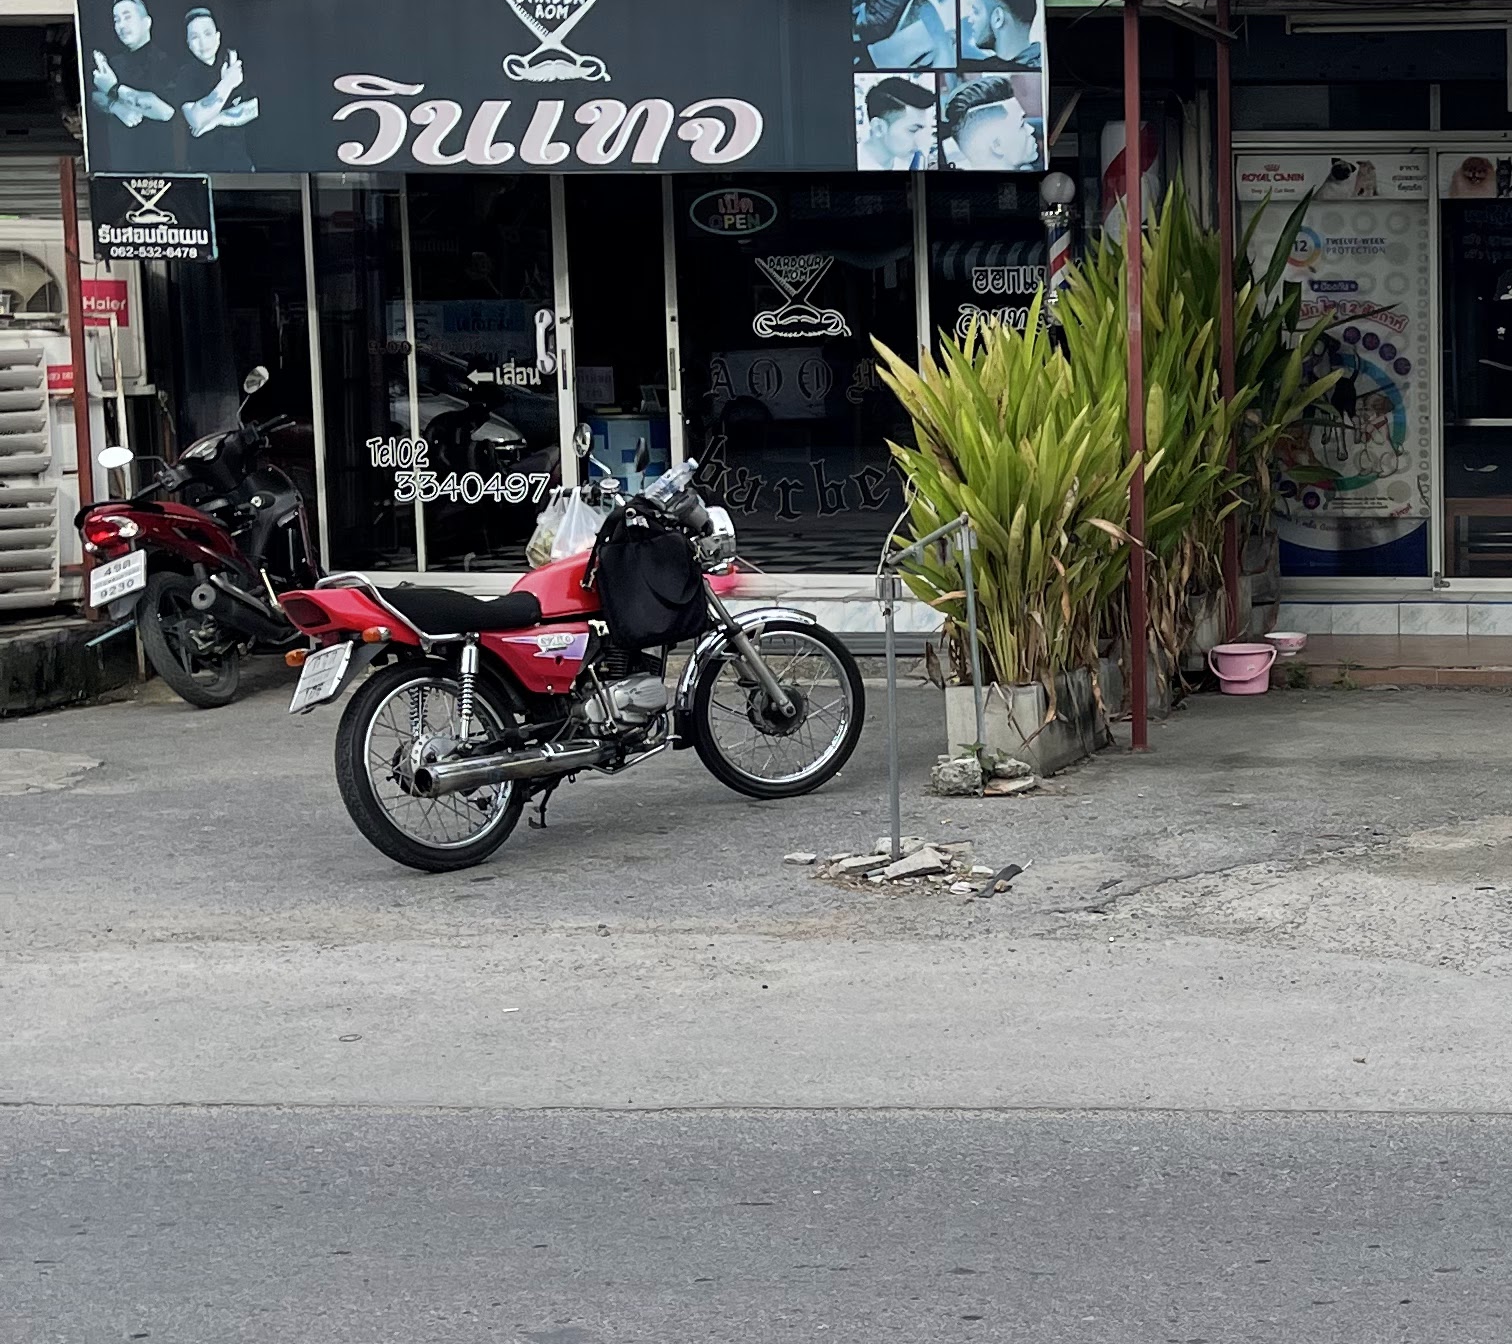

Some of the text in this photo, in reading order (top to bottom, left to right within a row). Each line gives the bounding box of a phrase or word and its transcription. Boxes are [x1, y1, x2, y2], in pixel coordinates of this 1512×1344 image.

[535, 3, 569, 20] AOM
[332, 73, 764, 165] วินเทจ
[1242, 173, 1304, 182] ROYAL CANIN
[708, 214, 761, 229] OPEN
[1326, 246, 1386, 255] PROTECTION
[83, 297, 126, 311] Haier
[496, 358, 541, 385] เลื่อน
[394, 471, 550, 504] 3340497
